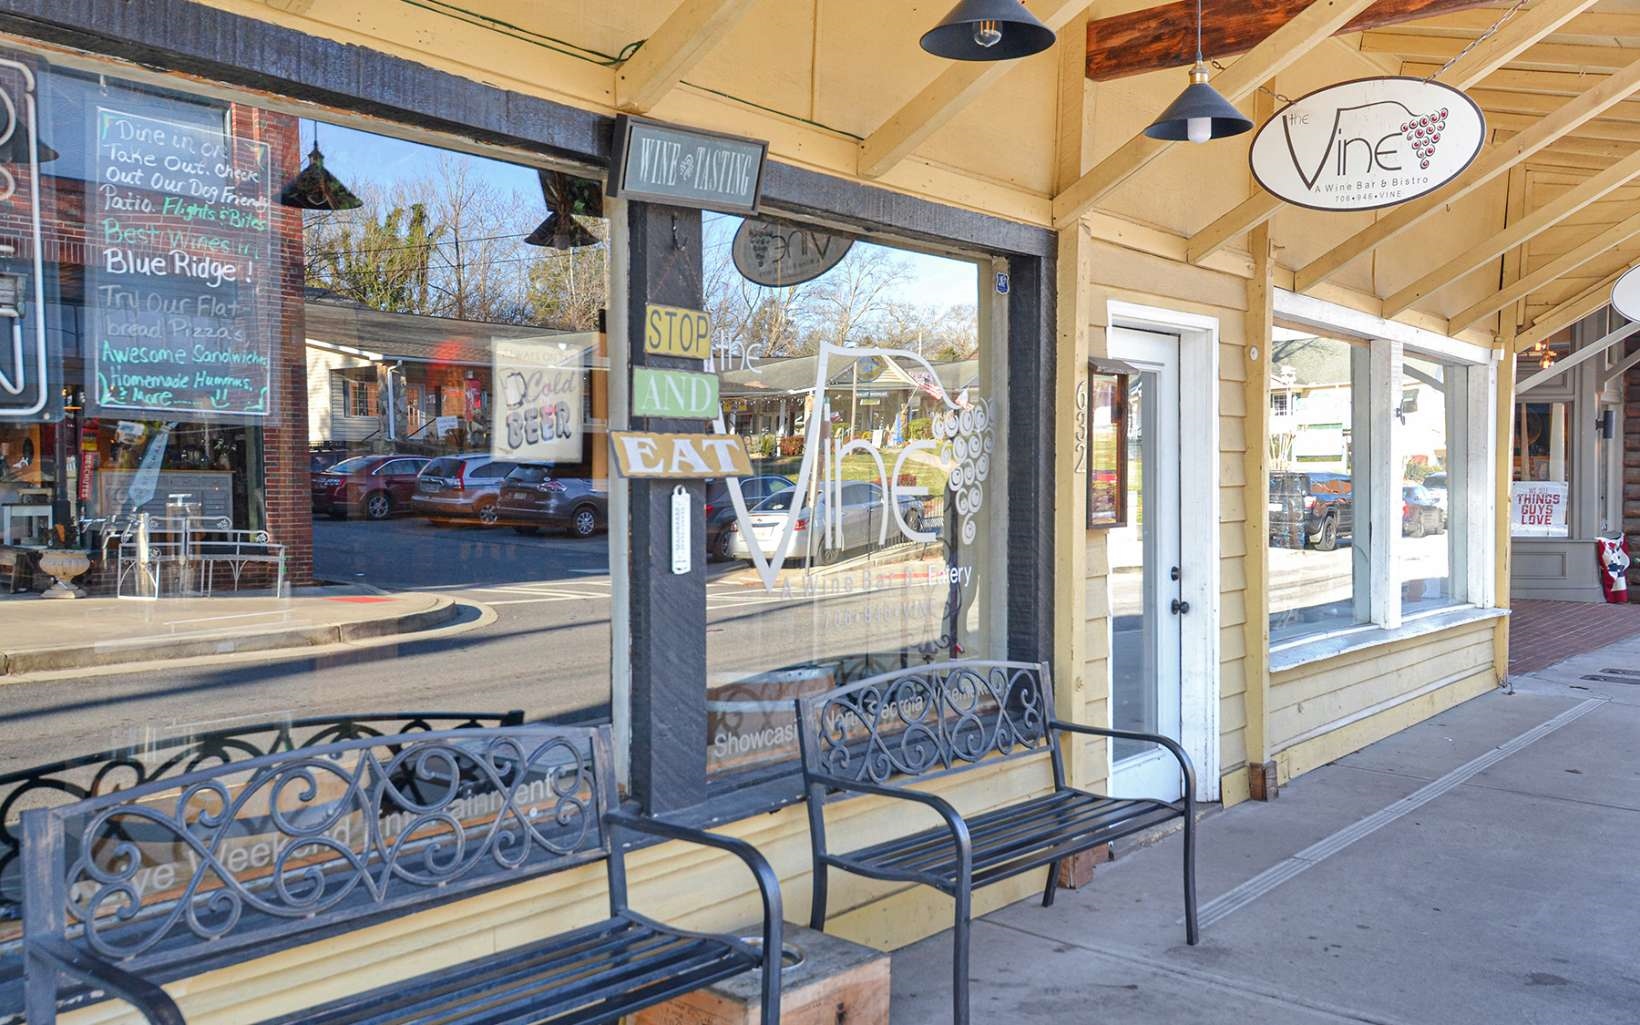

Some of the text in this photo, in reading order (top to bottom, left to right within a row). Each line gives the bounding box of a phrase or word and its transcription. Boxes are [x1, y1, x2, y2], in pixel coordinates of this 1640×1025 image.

[115, 119, 166, 146] Dine
[1290, 113, 1309, 126] the
[103, 143, 158, 167] Take
[1282, 108, 1402, 190] Vine
[639, 137, 753, 196] WINE TASTING
[105, 166, 145, 185] Out
[151, 172, 186, 193] Our
[188, 178, 219, 205] Dog
[1325, 183, 1352, 192] Wine
[1356, 180, 1376, 190] Bar
[1392, 176, 1428, 187] Bistro
[162, 196, 215, 222] Flights
[101, 217, 161, 245] Best
[167, 228, 231, 254] Wines
[103, 248, 168, 276] Blue
[99, 284, 139, 321] Try
[146, 293, 193, 315] Our
[106, 312, 162, 338] bread
[649, 309, 709, 352] STOP
[102, 339, 187, 365] Awesome
[109, 365, 190, 388] Homemade
[525, 371, 576, 403] Cold
[641, 375, 712, 412] AND
[506, 401, 572, 450] BEER
[620, 436, 740, 474] EAT
[704, 341, 938, 593] Vine
[1517, 494, 1560, 505] THINGS
[1521, 504, 1553, 515] GUYS
[1521, 515, 1552, 526] LOVE
[928, 563, 972, 588] Eatery
[714, 720, 800, 757] Showcasi
